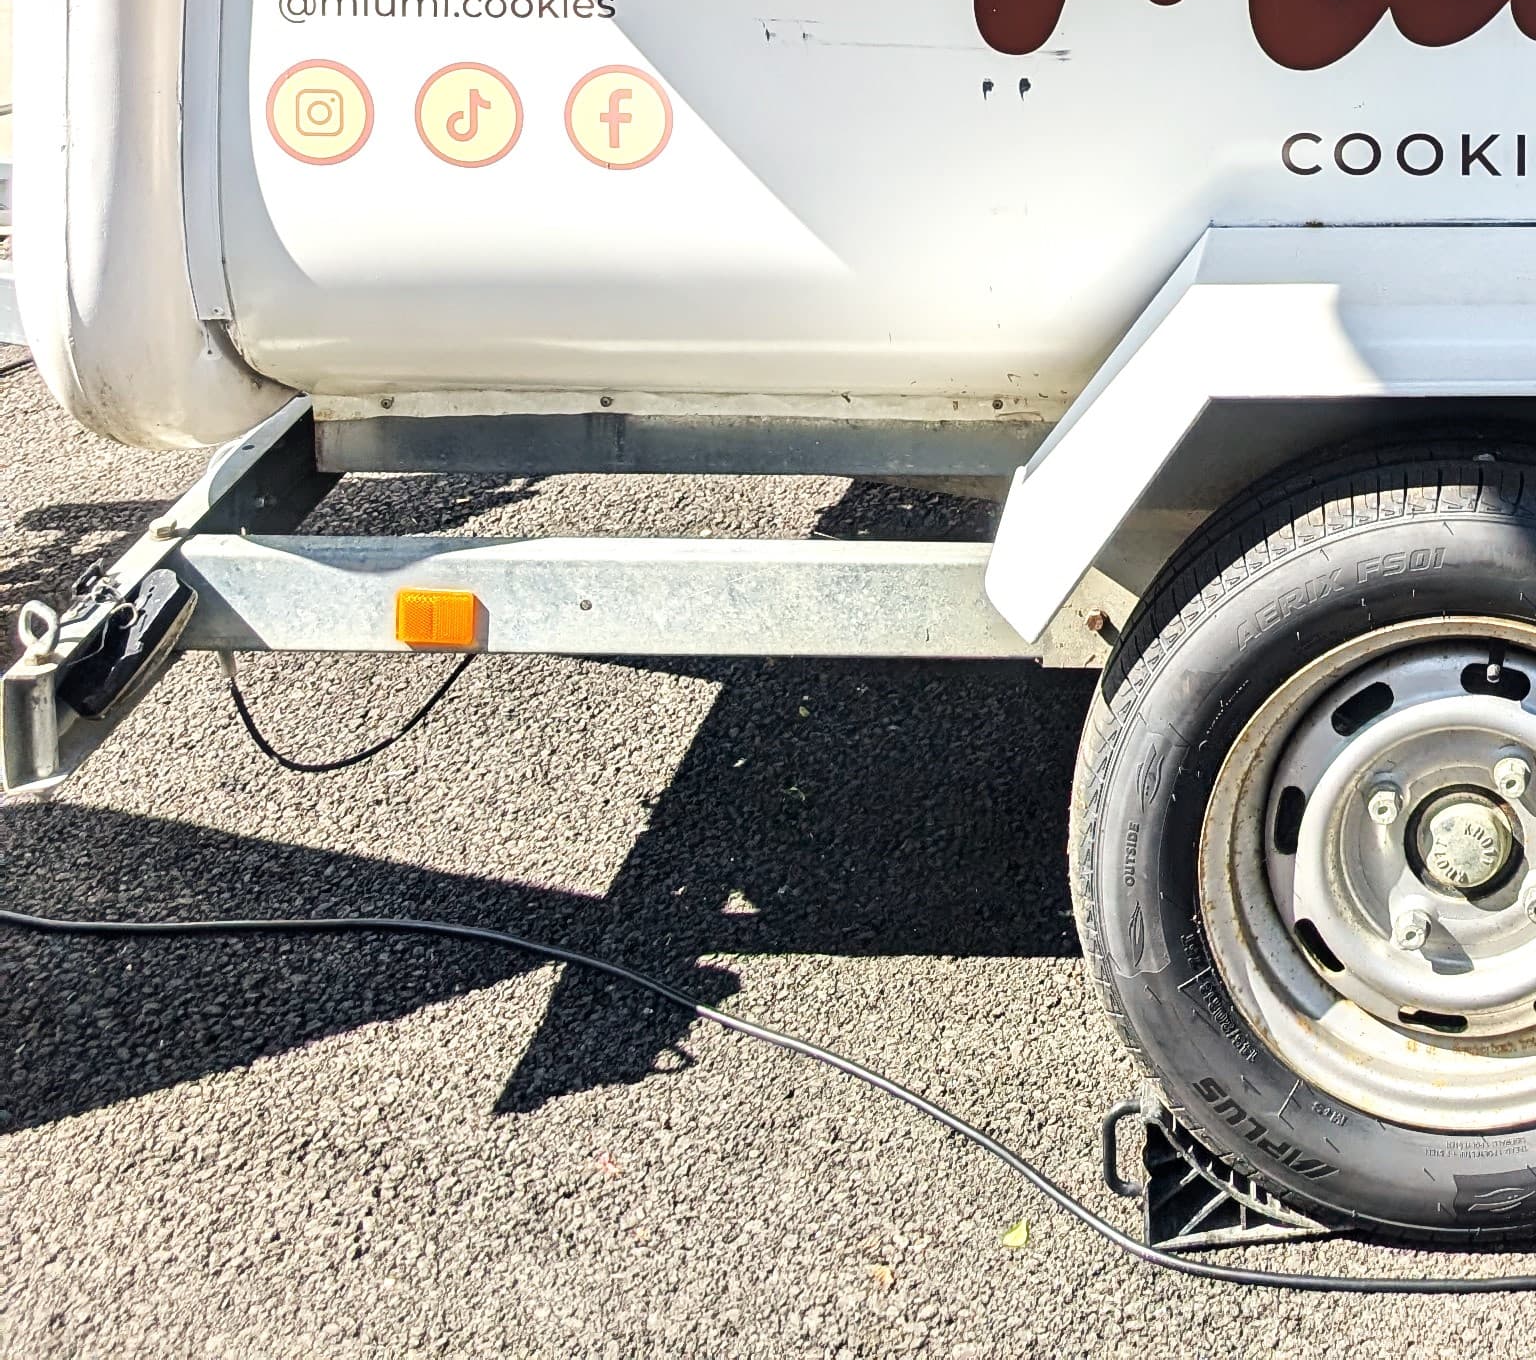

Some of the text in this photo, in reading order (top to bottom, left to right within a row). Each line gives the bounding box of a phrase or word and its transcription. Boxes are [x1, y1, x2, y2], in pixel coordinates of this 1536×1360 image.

[1236, 546, 1448, 652] AERIX FS01
[1123, 821, 1141, 888] OUTSIDE
